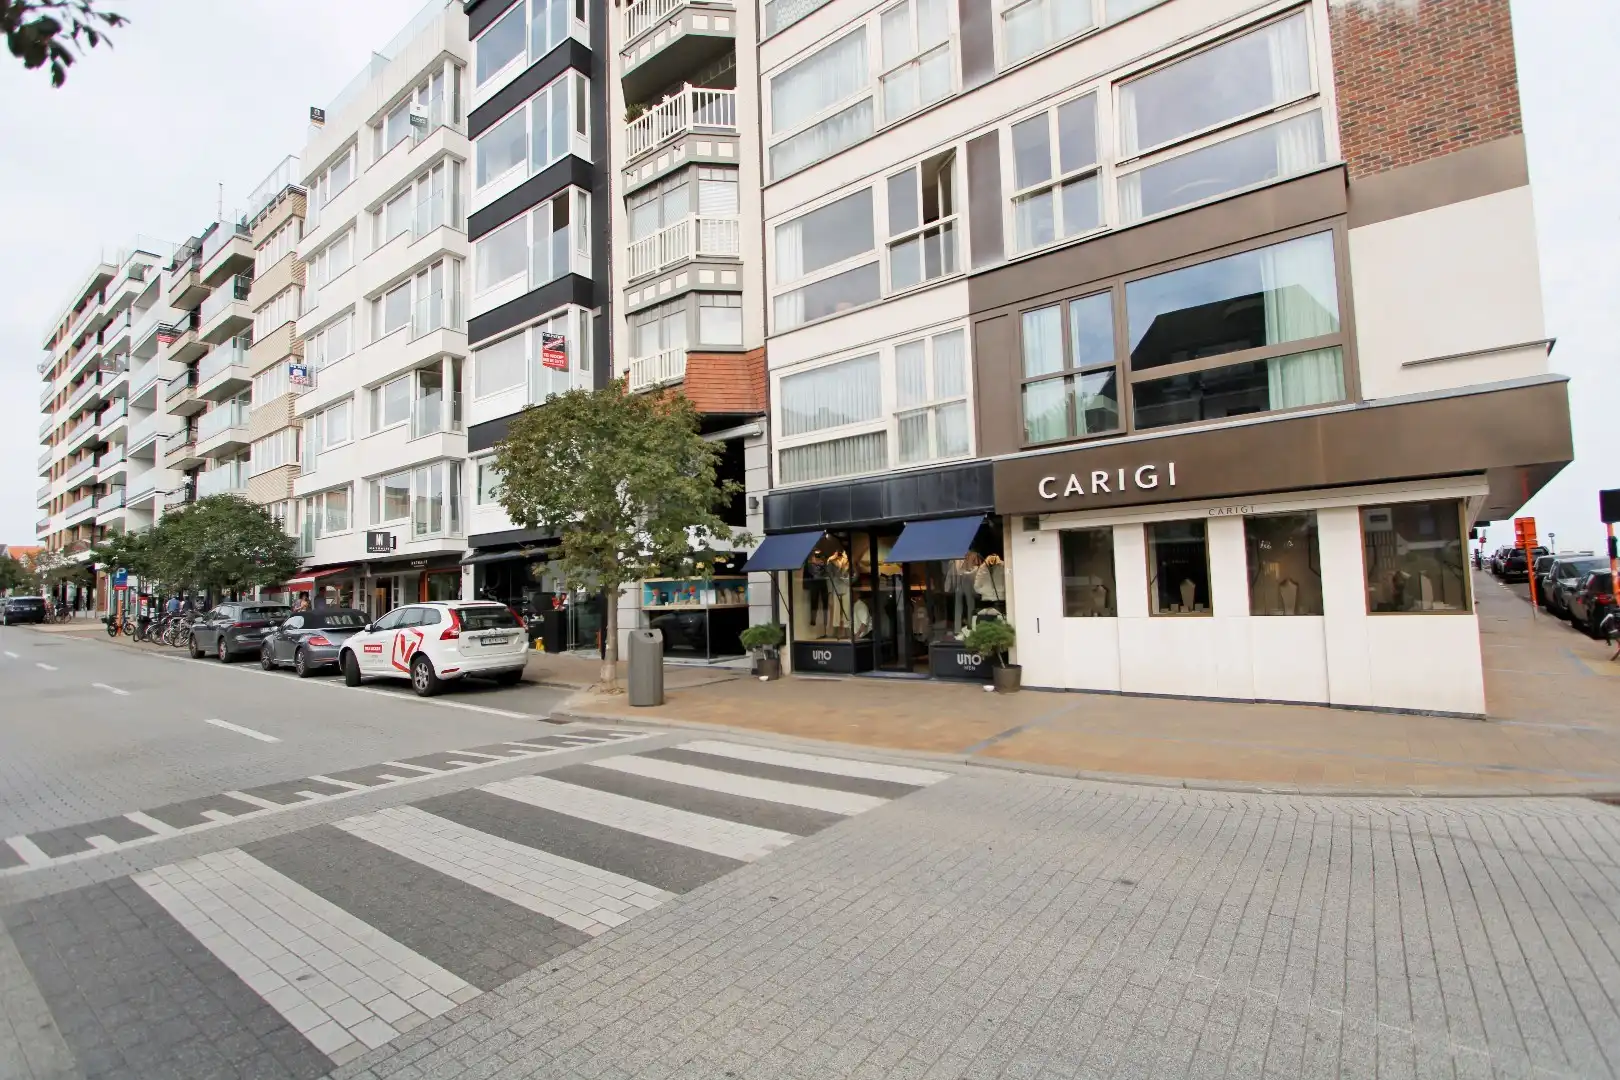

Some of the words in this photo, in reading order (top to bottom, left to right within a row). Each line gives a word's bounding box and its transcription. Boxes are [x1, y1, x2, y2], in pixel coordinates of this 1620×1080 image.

[1038, 462, 1176, 499] CARIGI
[1208, 505, 1255, 515] CARIGI
[116, 567, 127, 579] P
[812, 650, 832, 660] UNO
[956, 653, 982, 666] UNO
